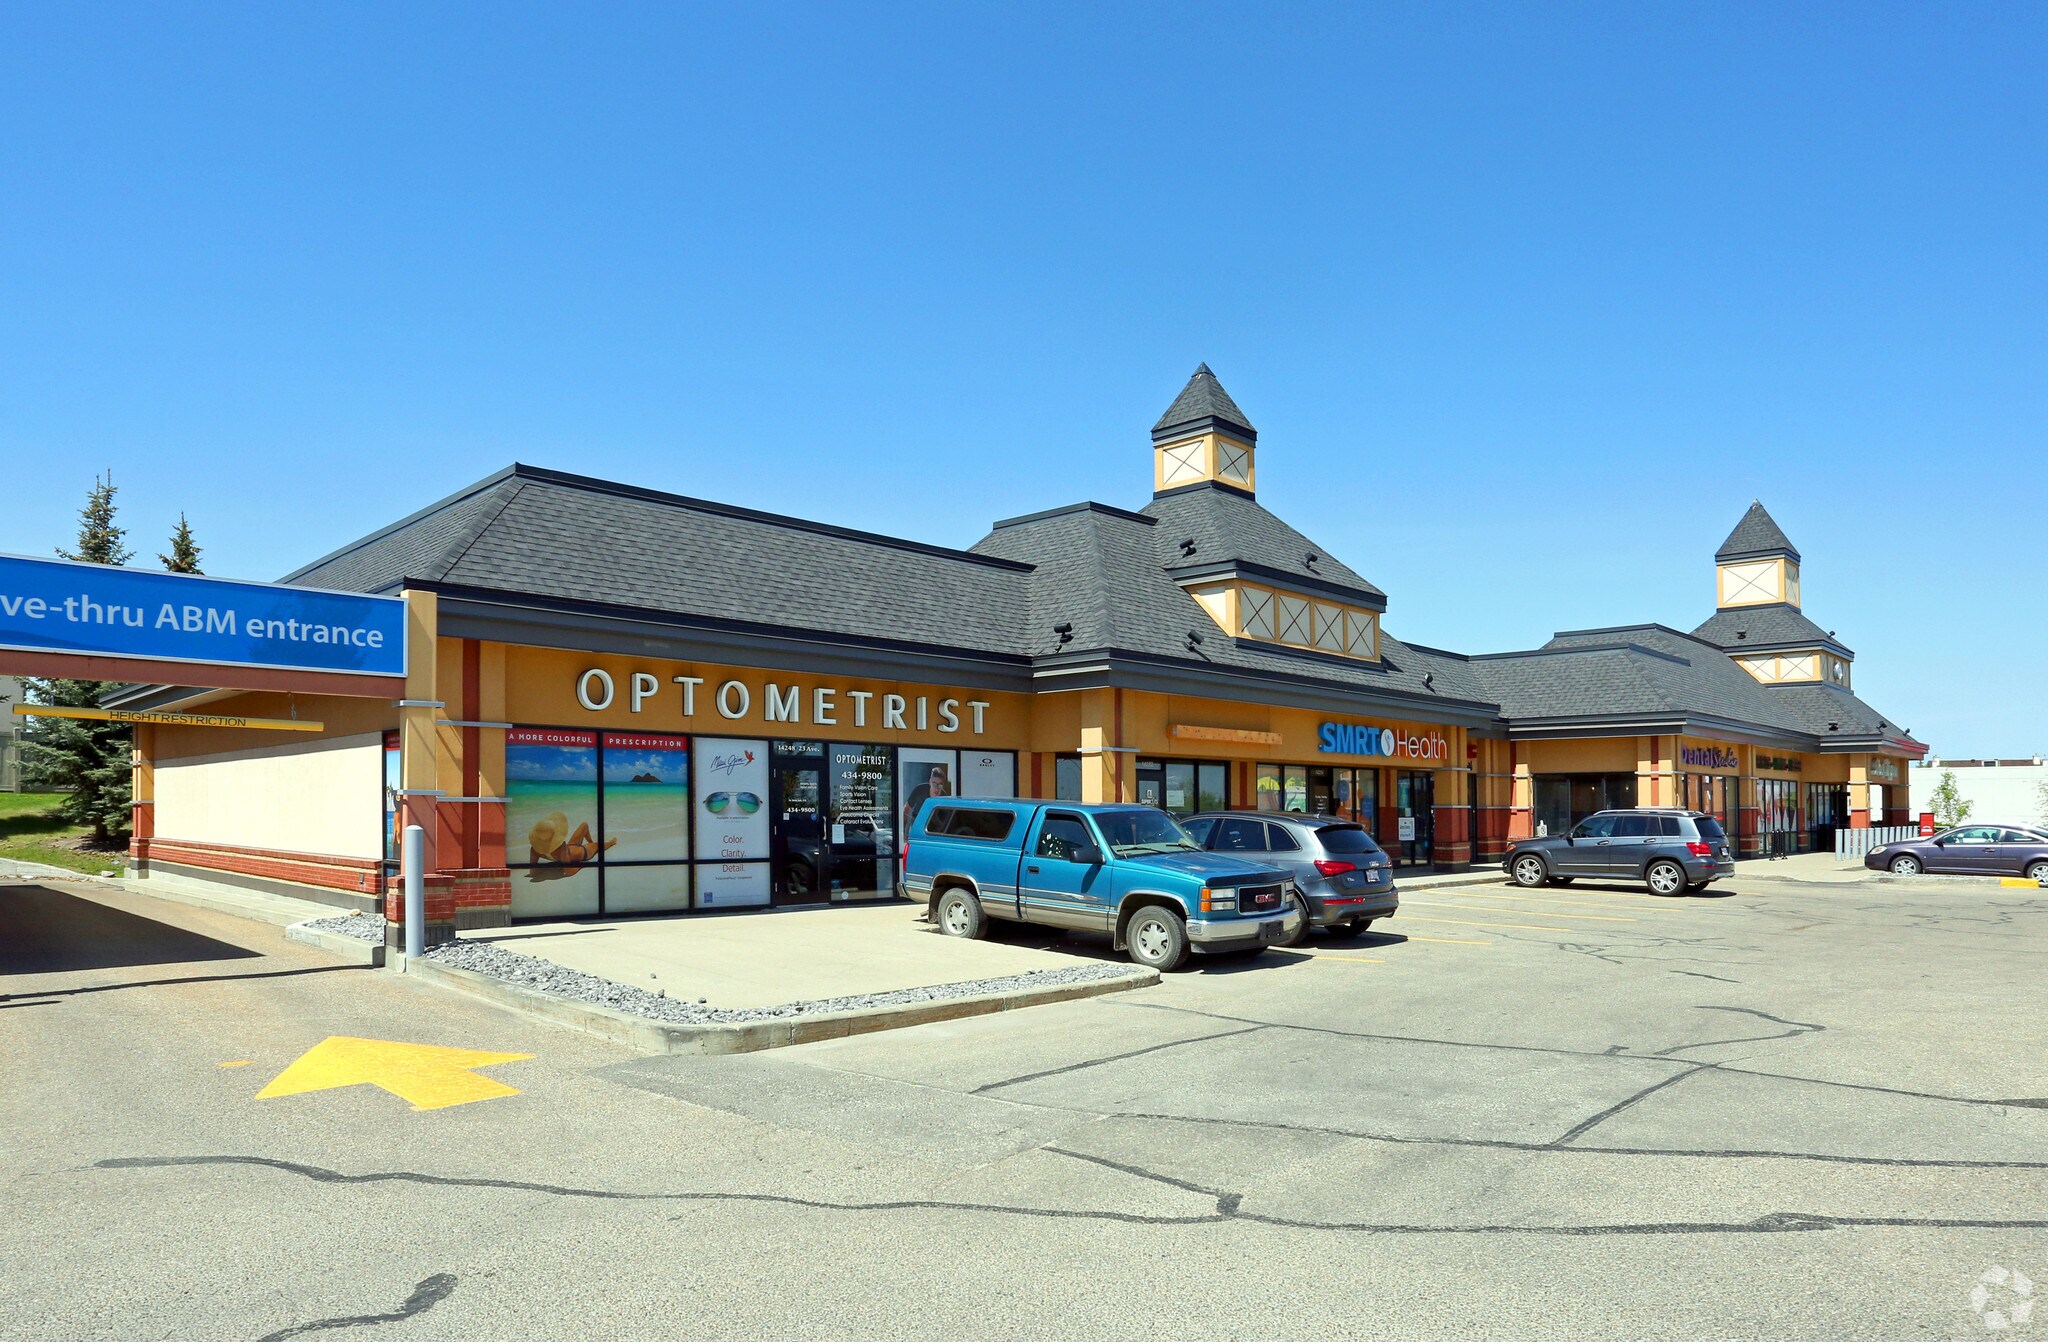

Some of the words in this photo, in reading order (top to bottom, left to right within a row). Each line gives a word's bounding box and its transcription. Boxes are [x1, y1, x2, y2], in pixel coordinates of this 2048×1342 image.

[154, 603, 237, 636] ABM
[245, 612, 384, 648] entrance
[576, 668, 990, 734] OPTOMETRIST
[109, 711, 159, 721] HEIGHT
[161, 713, 246, 727] RESTRICTION
[508, 732, 515, 740] A
[518, 733, 543, 741] MORE
[546, 734, 592, 744] COLORFUL
[608, 737, 682, 747] PRESCRIPTION
[1318, 722, 1381, 755] SMRT
[1396, 728, 1448, 760] Health
[836, 754, 886, 766] OPTOMETRIST
[1681, 744, 1715, 768] Dental
[841, 771, 882, 780] 434-9800
[722, 835, 745, 844] Color.
[720, 848, 747, 859] Clarity.
[722, 864, 746, 873] Detail.
